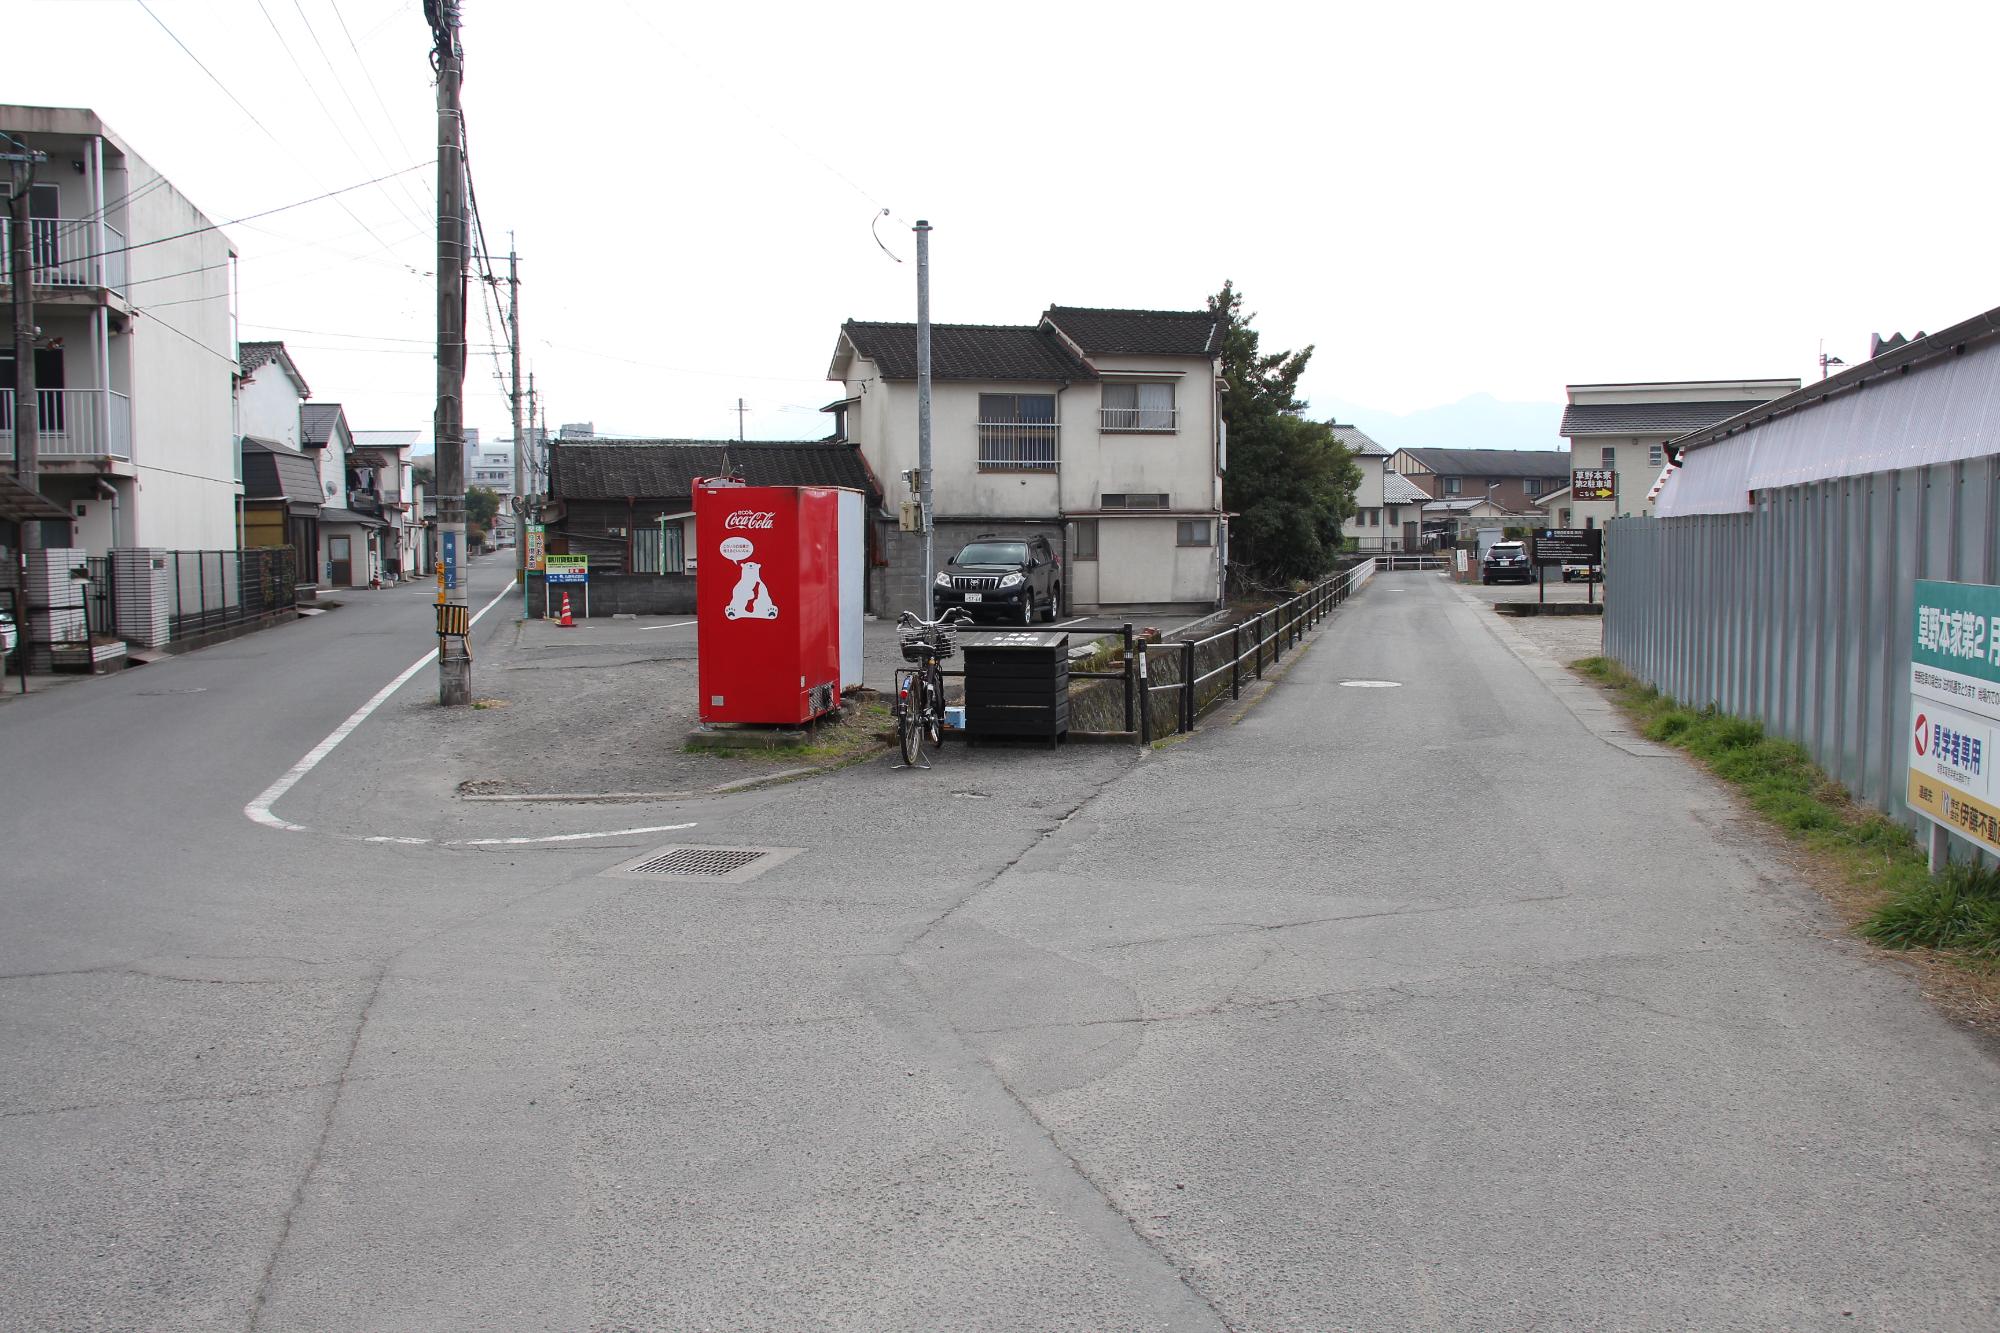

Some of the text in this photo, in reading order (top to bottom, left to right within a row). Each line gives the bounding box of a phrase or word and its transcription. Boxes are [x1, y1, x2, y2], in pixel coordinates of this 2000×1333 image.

[724, 511, 776, 530] Coca-Cola
[1932, 724, 1981, 776] 見学者専用
[1960, 802, 2000, 845] 伊藤不動
